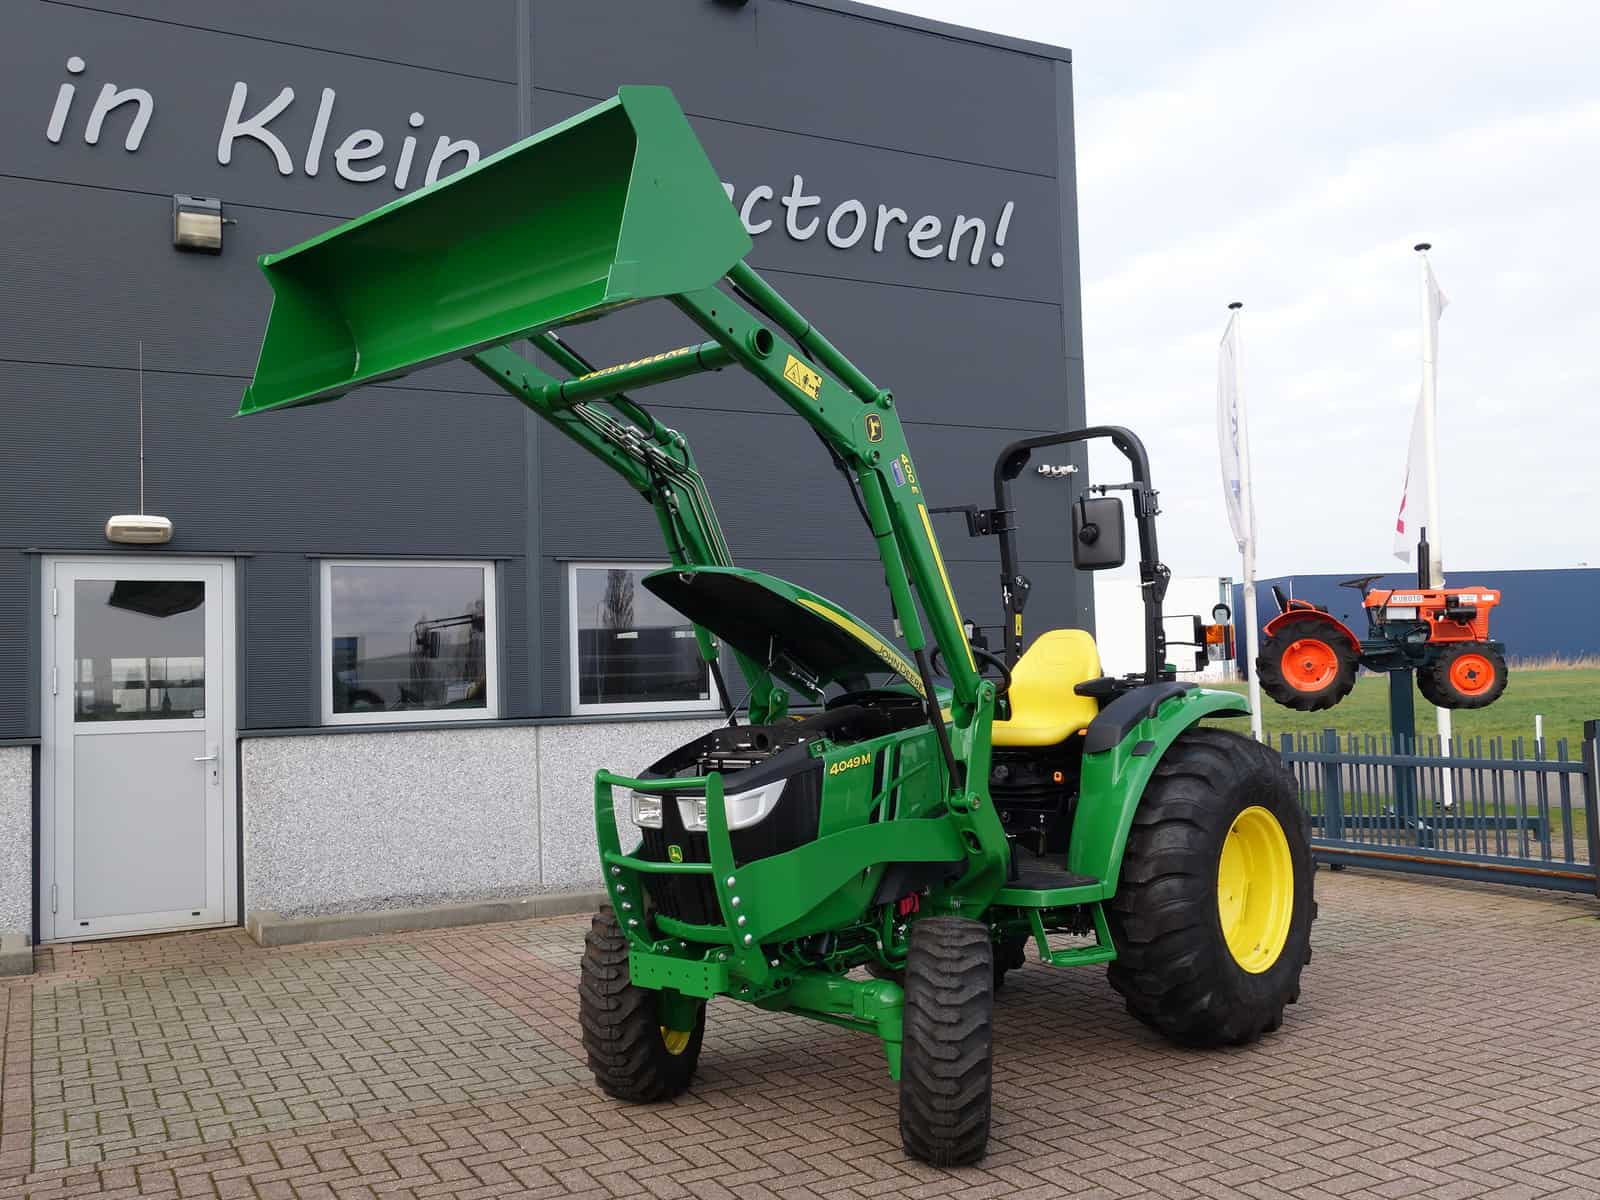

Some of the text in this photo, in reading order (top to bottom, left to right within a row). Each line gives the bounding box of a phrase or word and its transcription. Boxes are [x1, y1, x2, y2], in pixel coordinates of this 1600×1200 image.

[47, 57, 1015, 268] in Klein ctoren!
